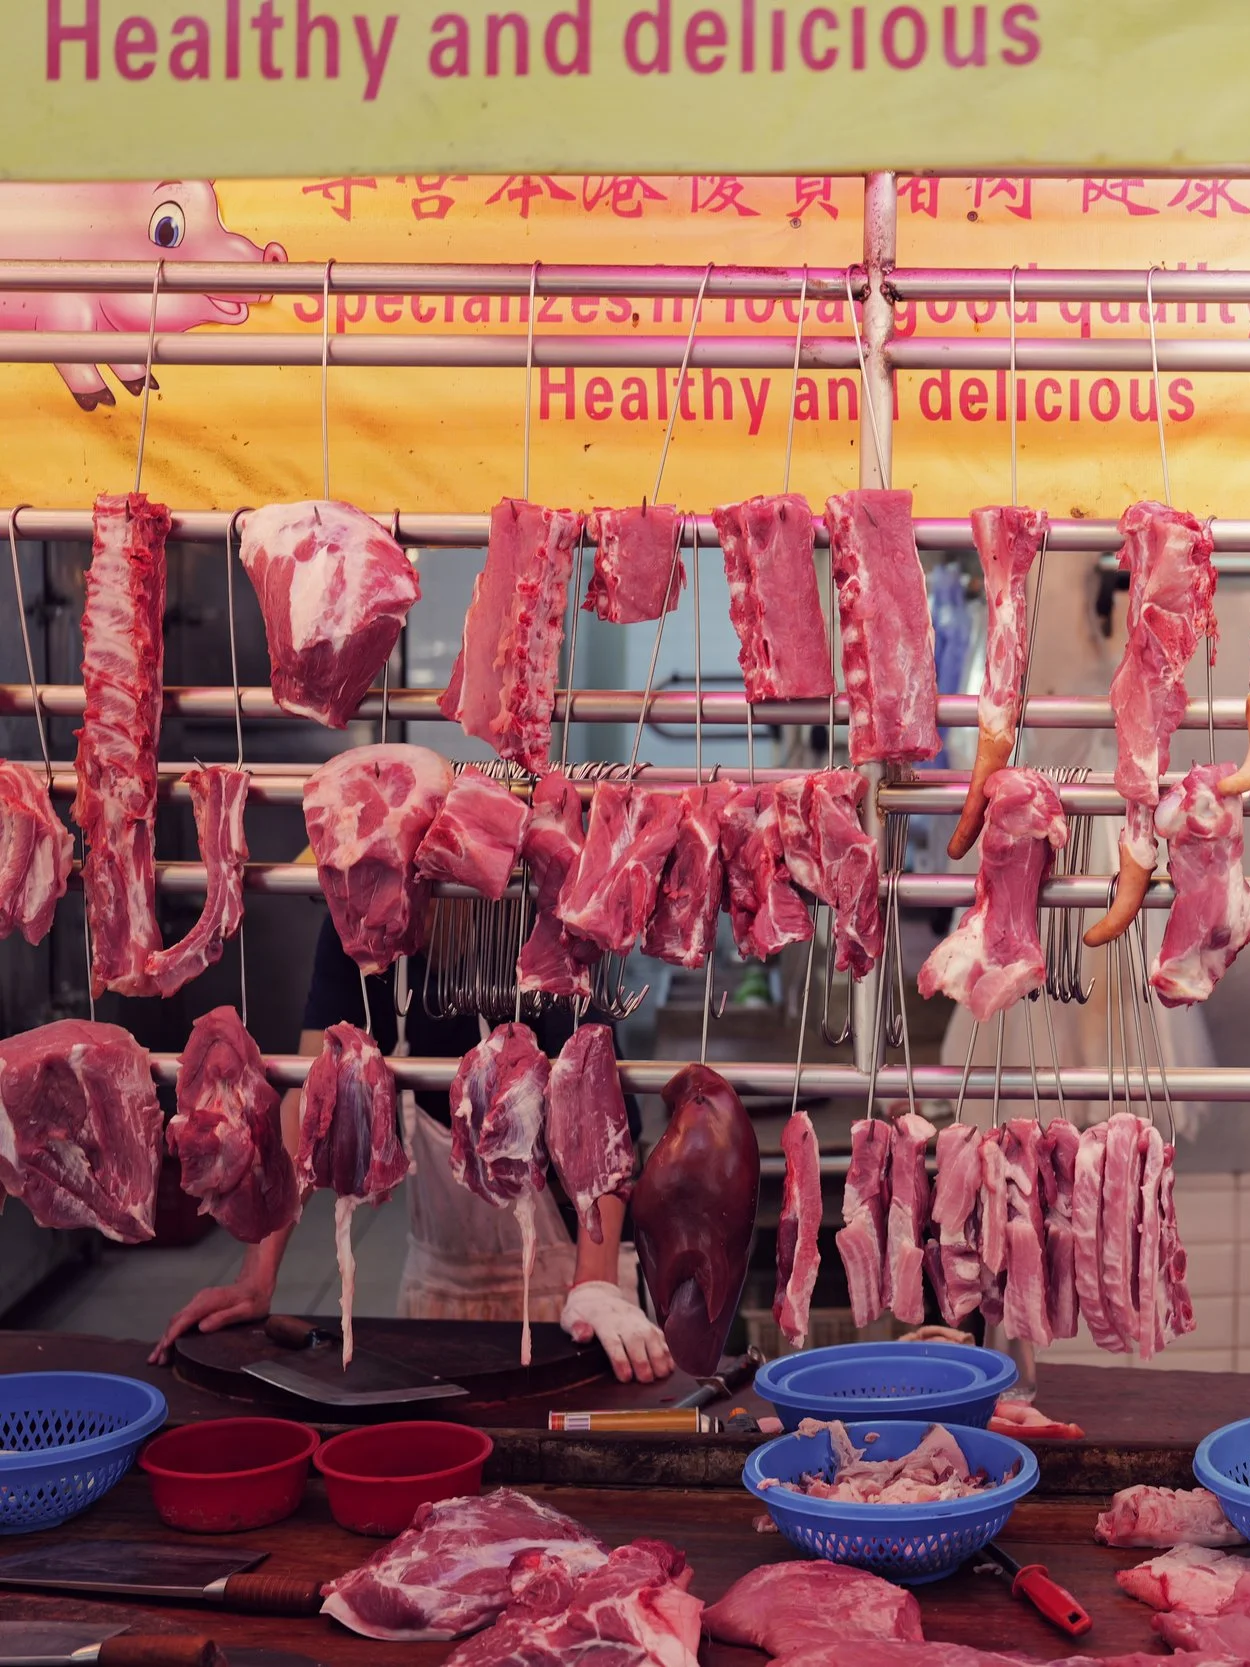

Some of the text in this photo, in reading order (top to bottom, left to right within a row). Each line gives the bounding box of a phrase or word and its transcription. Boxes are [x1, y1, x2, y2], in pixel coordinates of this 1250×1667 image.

[46, 0, 1042, 101] Healthy and delicious
[539, 368, 772, 436] Healthy
[919, 369, 1195, 422] delicious
